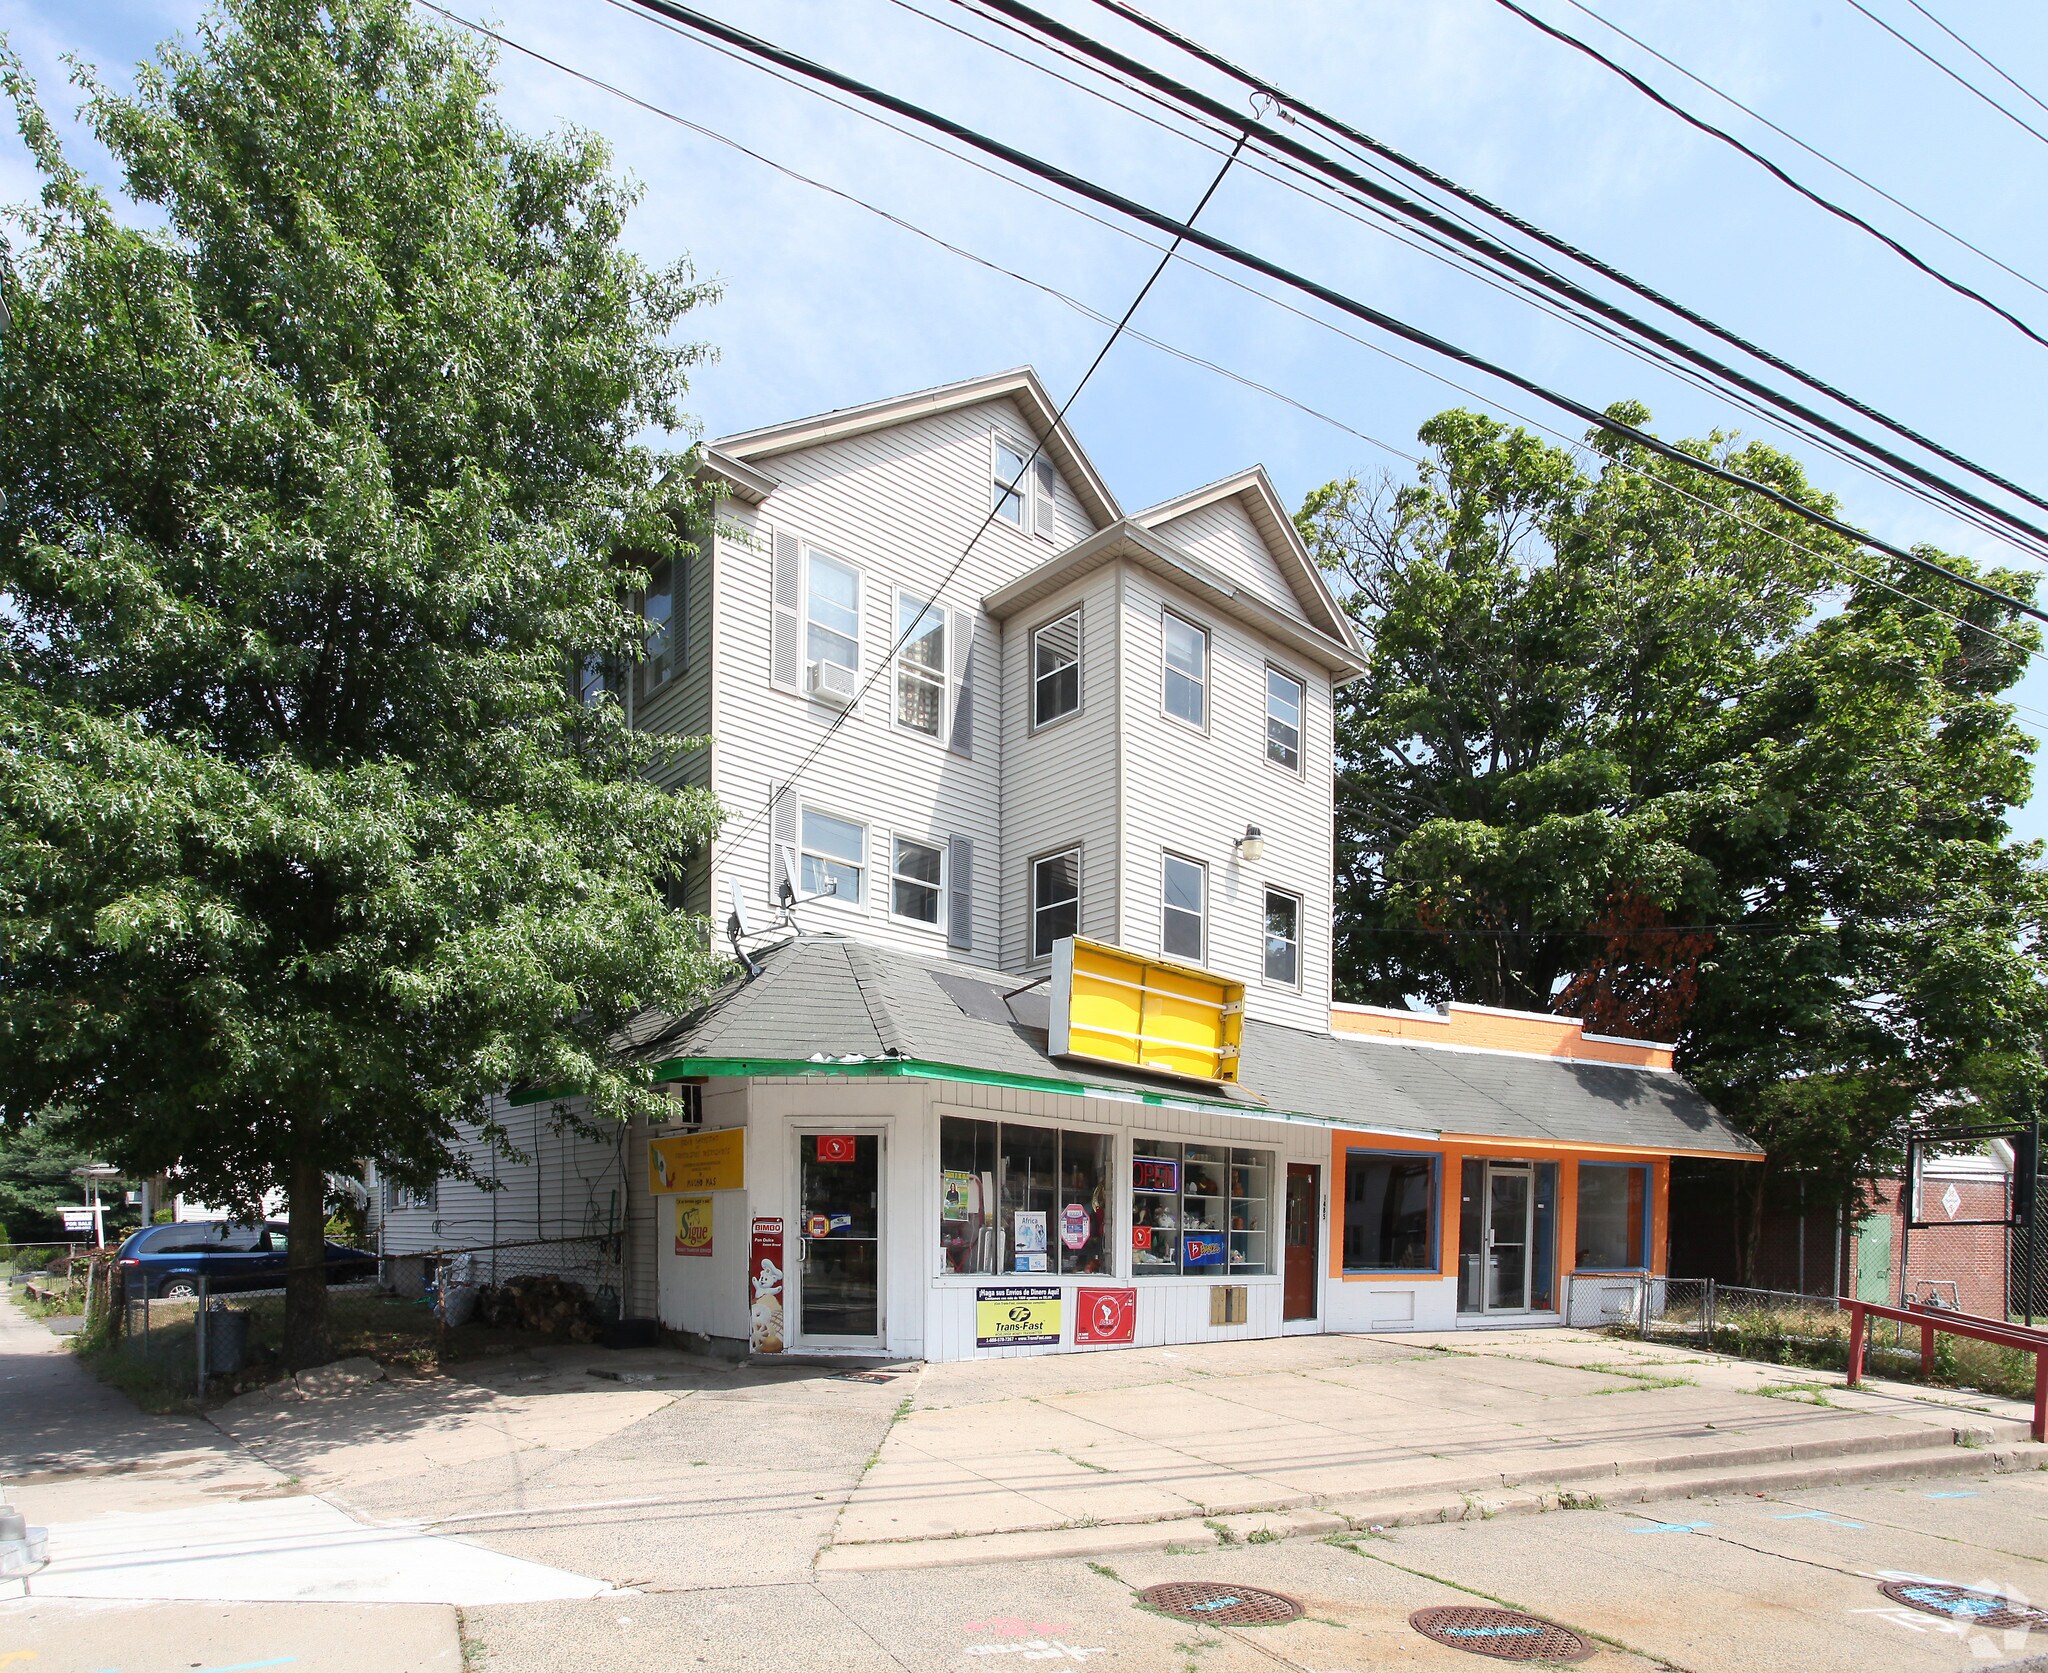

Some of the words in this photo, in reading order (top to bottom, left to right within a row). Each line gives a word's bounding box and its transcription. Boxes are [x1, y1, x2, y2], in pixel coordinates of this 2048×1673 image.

[1133, 1161, 1175, 1189] OPEN
[680, 1211, 708, 1245] Sigue
[1023, 1288, 1030, 1296] de
[1030, 1288, 1047, 1296] Dinero
[996, 1321, 1043, 1331] Trans-Fast
